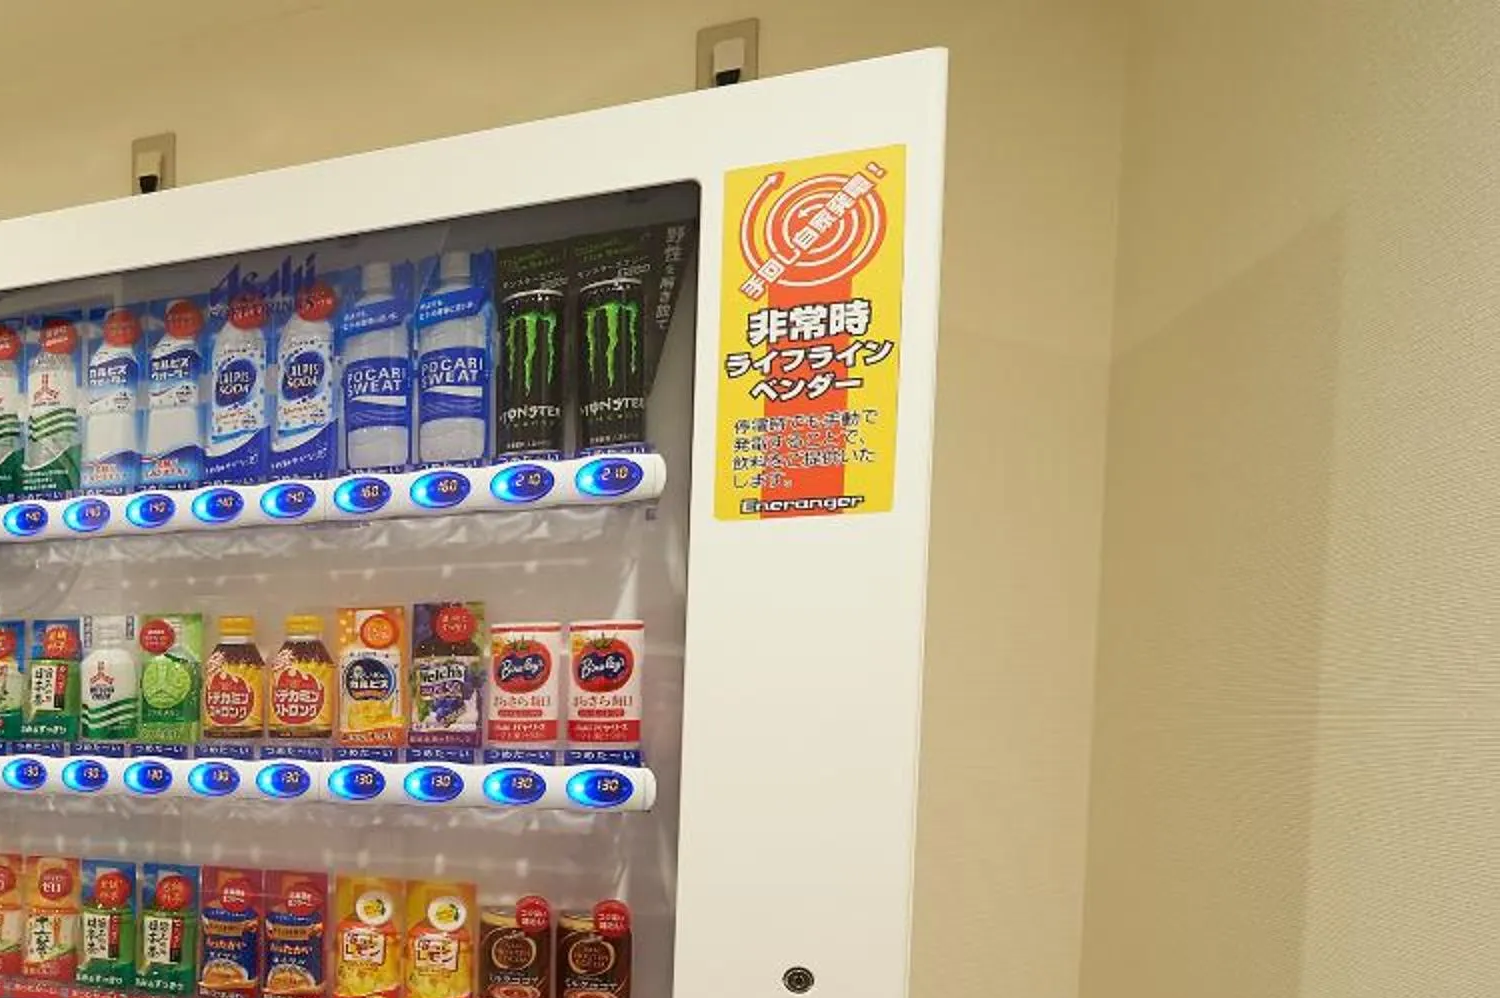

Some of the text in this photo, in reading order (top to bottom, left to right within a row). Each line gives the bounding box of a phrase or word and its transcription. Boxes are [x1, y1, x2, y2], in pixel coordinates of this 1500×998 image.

[747, 299, 872, 347] 非常時
[724, 339, 895, 378] ライフライン
[750, 372, 863, 402] ベンダー
